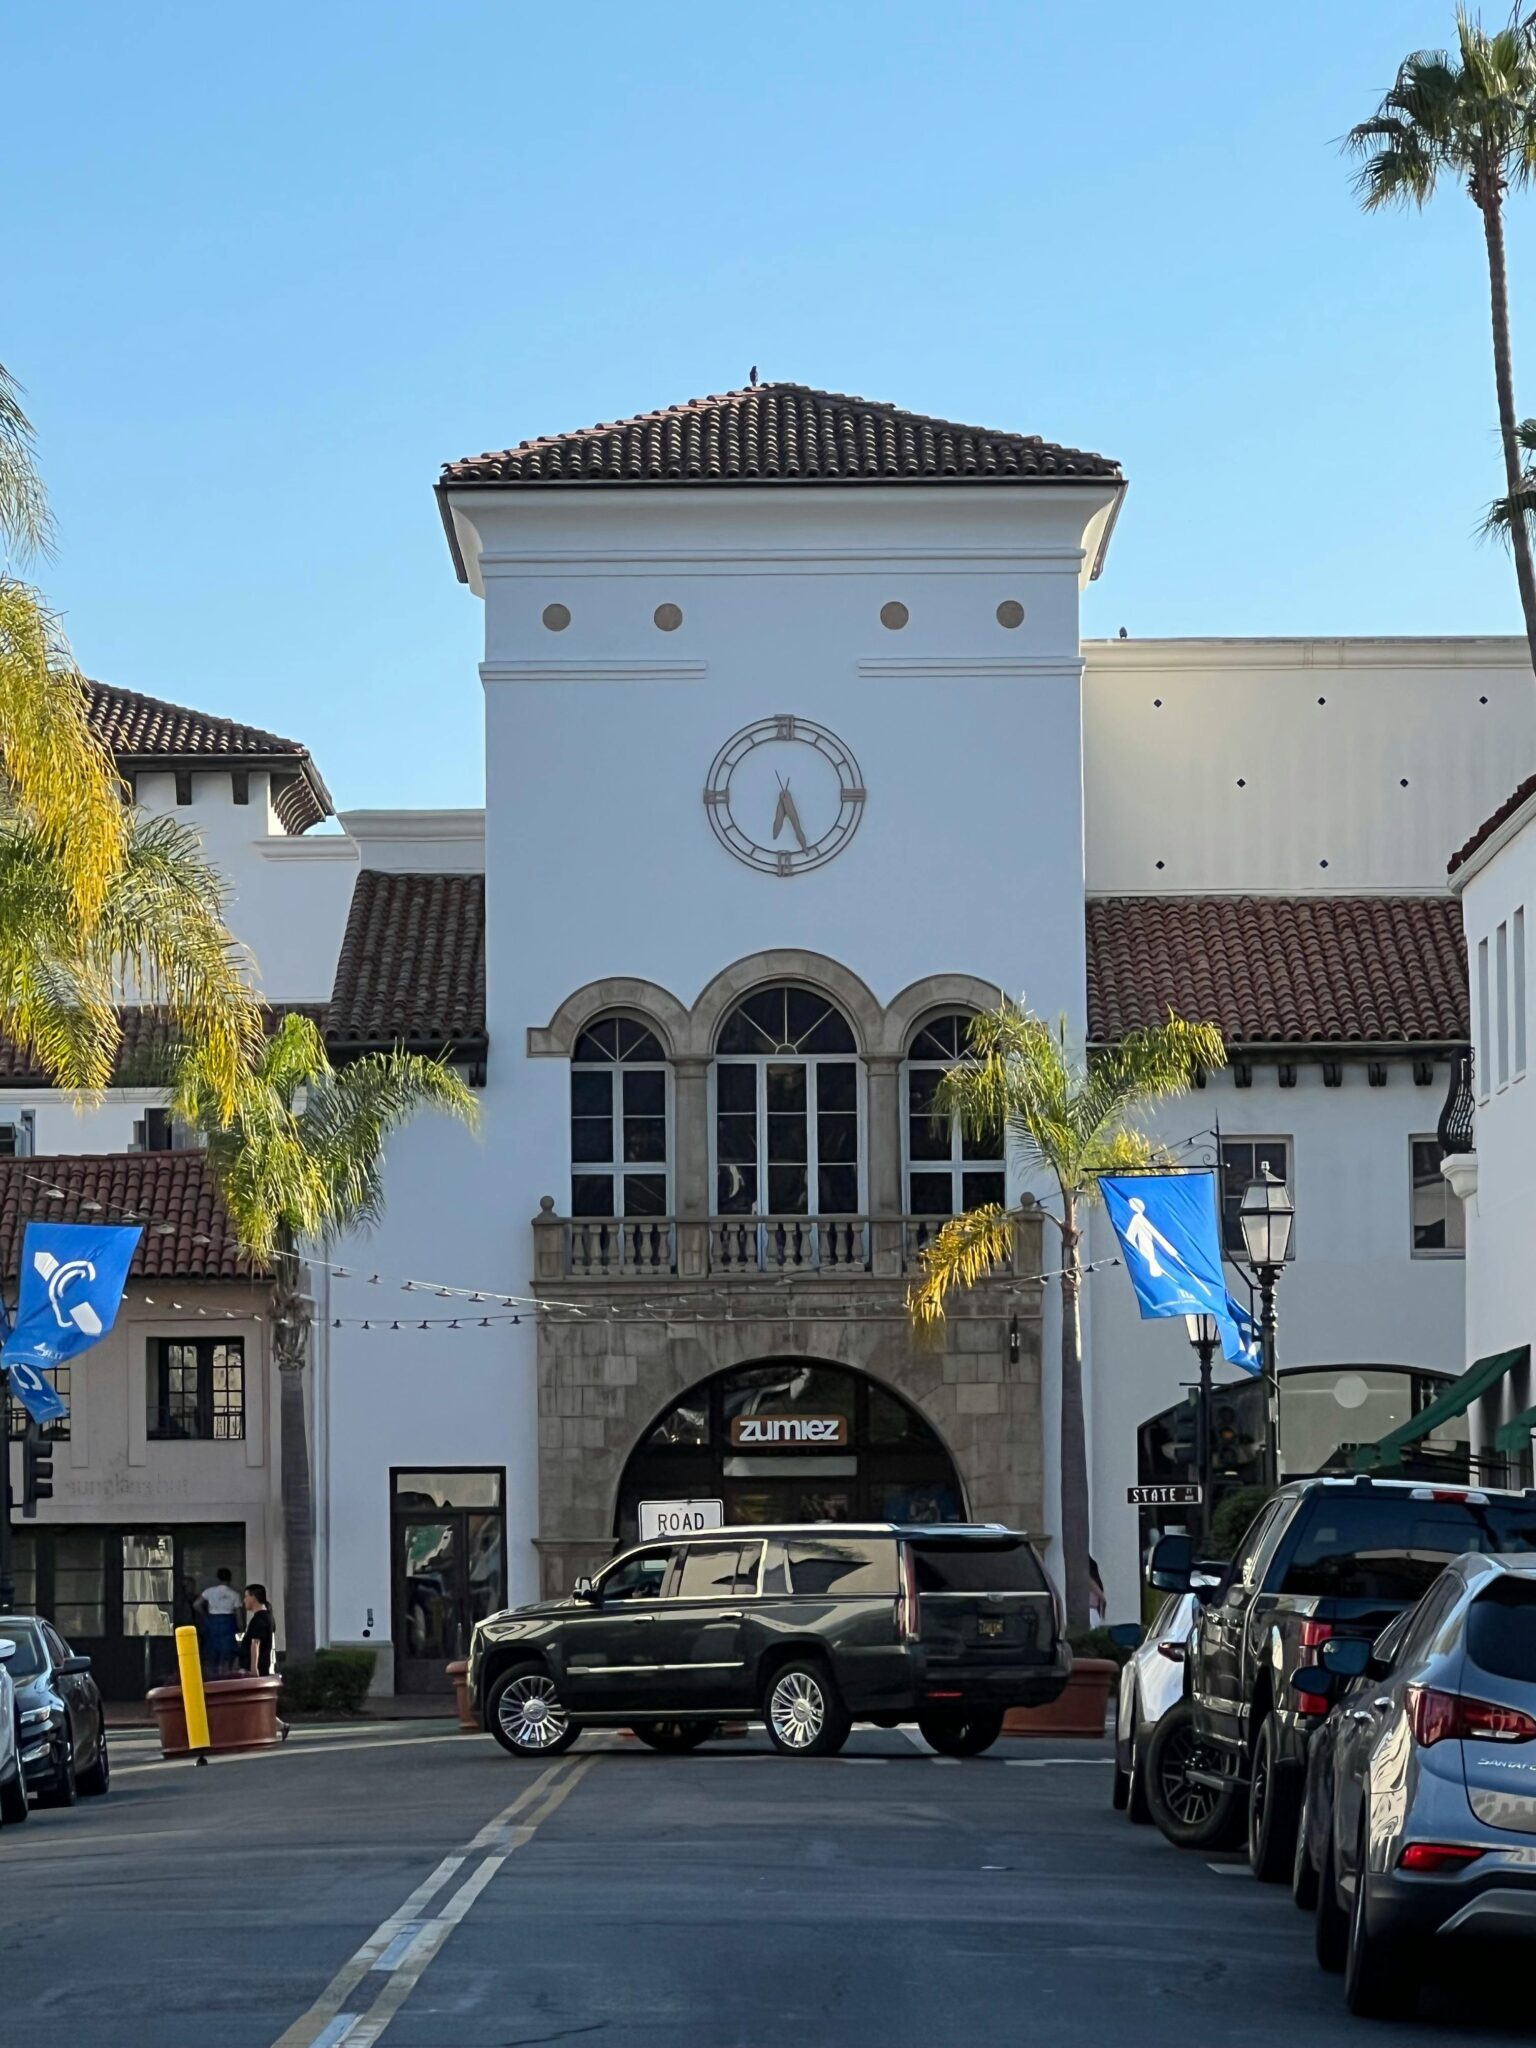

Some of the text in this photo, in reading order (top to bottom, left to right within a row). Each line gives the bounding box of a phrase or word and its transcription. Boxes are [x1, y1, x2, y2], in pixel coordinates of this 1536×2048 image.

[740, 1420, 839, 1441] zumiez
[1133, 1487, 1176, 1502] STATE
[658, 1512, 704, 1531] ROAD
